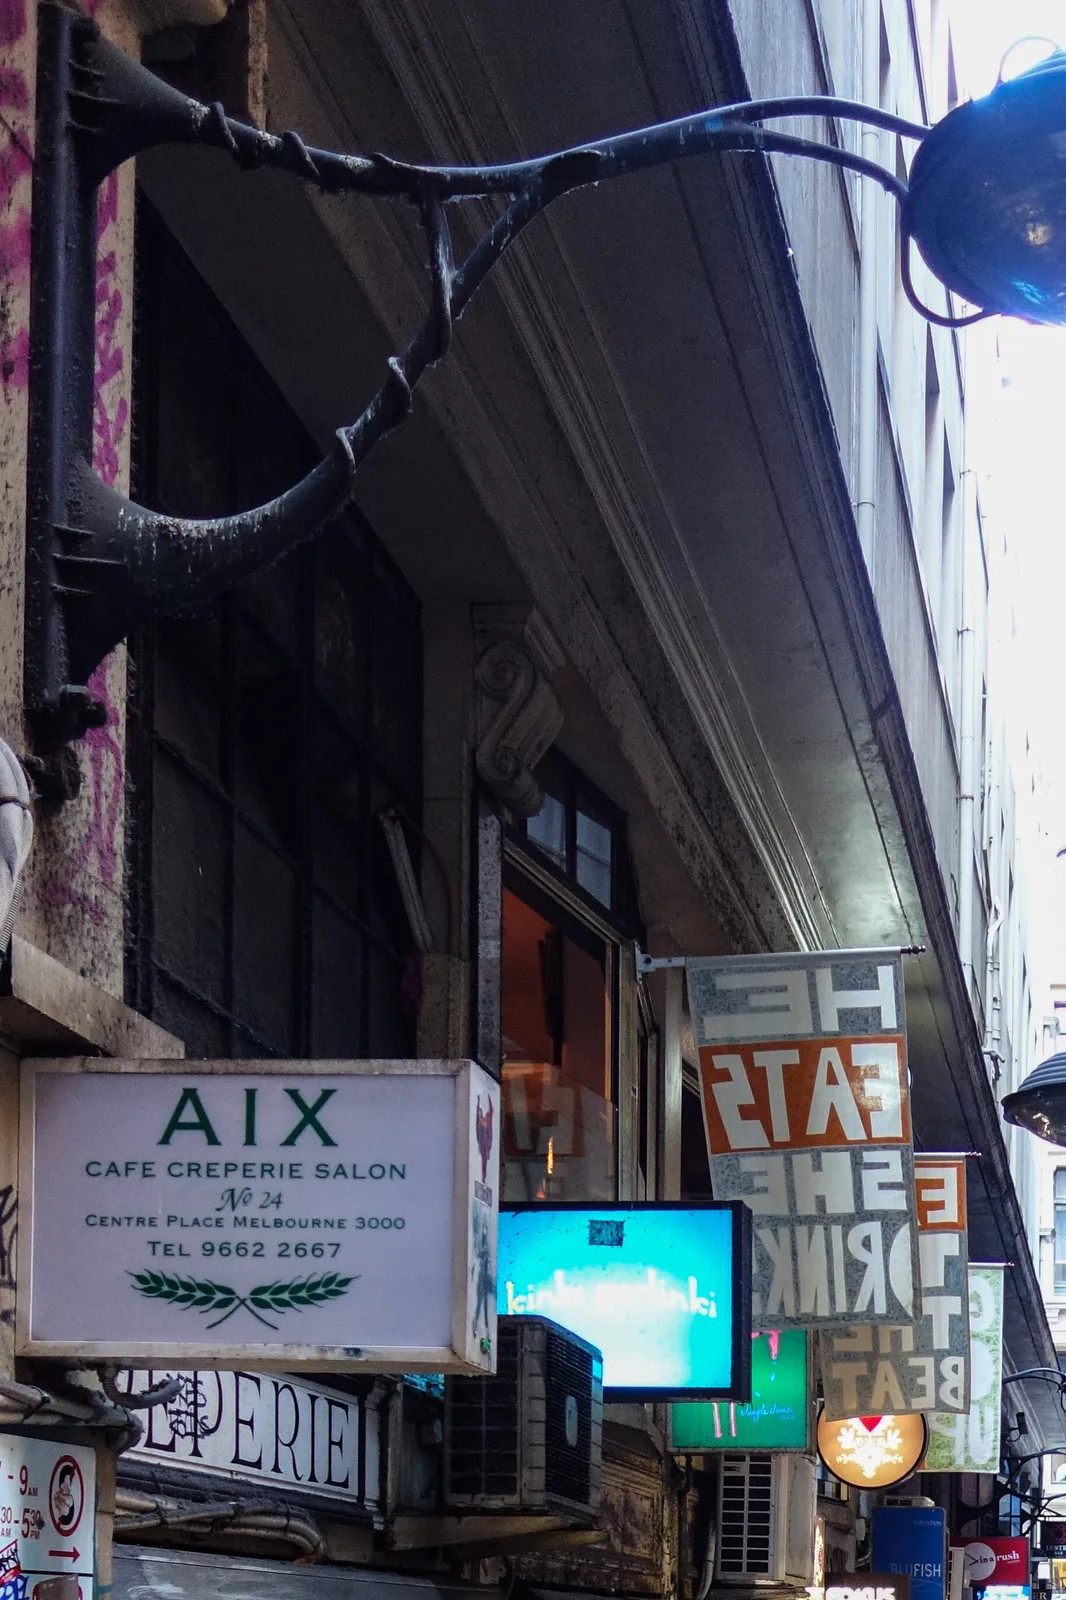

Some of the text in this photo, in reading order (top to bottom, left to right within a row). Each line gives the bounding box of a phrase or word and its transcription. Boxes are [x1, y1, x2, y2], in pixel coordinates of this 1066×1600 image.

[157, 1087, 339, 1147] AIX
[85, 1160, 407, 1180] CAFE CREPERIE SALON
[258, 1190, 283, 1210] 24
[355, 1215, 407, 1231] 3000
[201, 1241, 266, 1259] 9662
[277, 1242, 342, 1259] 2667
[739, 1404, 769, 1423] Jungle
[126, 1370, 351, 1489] EPERIE
[980, 1555, 988, 1564] in
[996, 1550, 1020, 1562] rush
